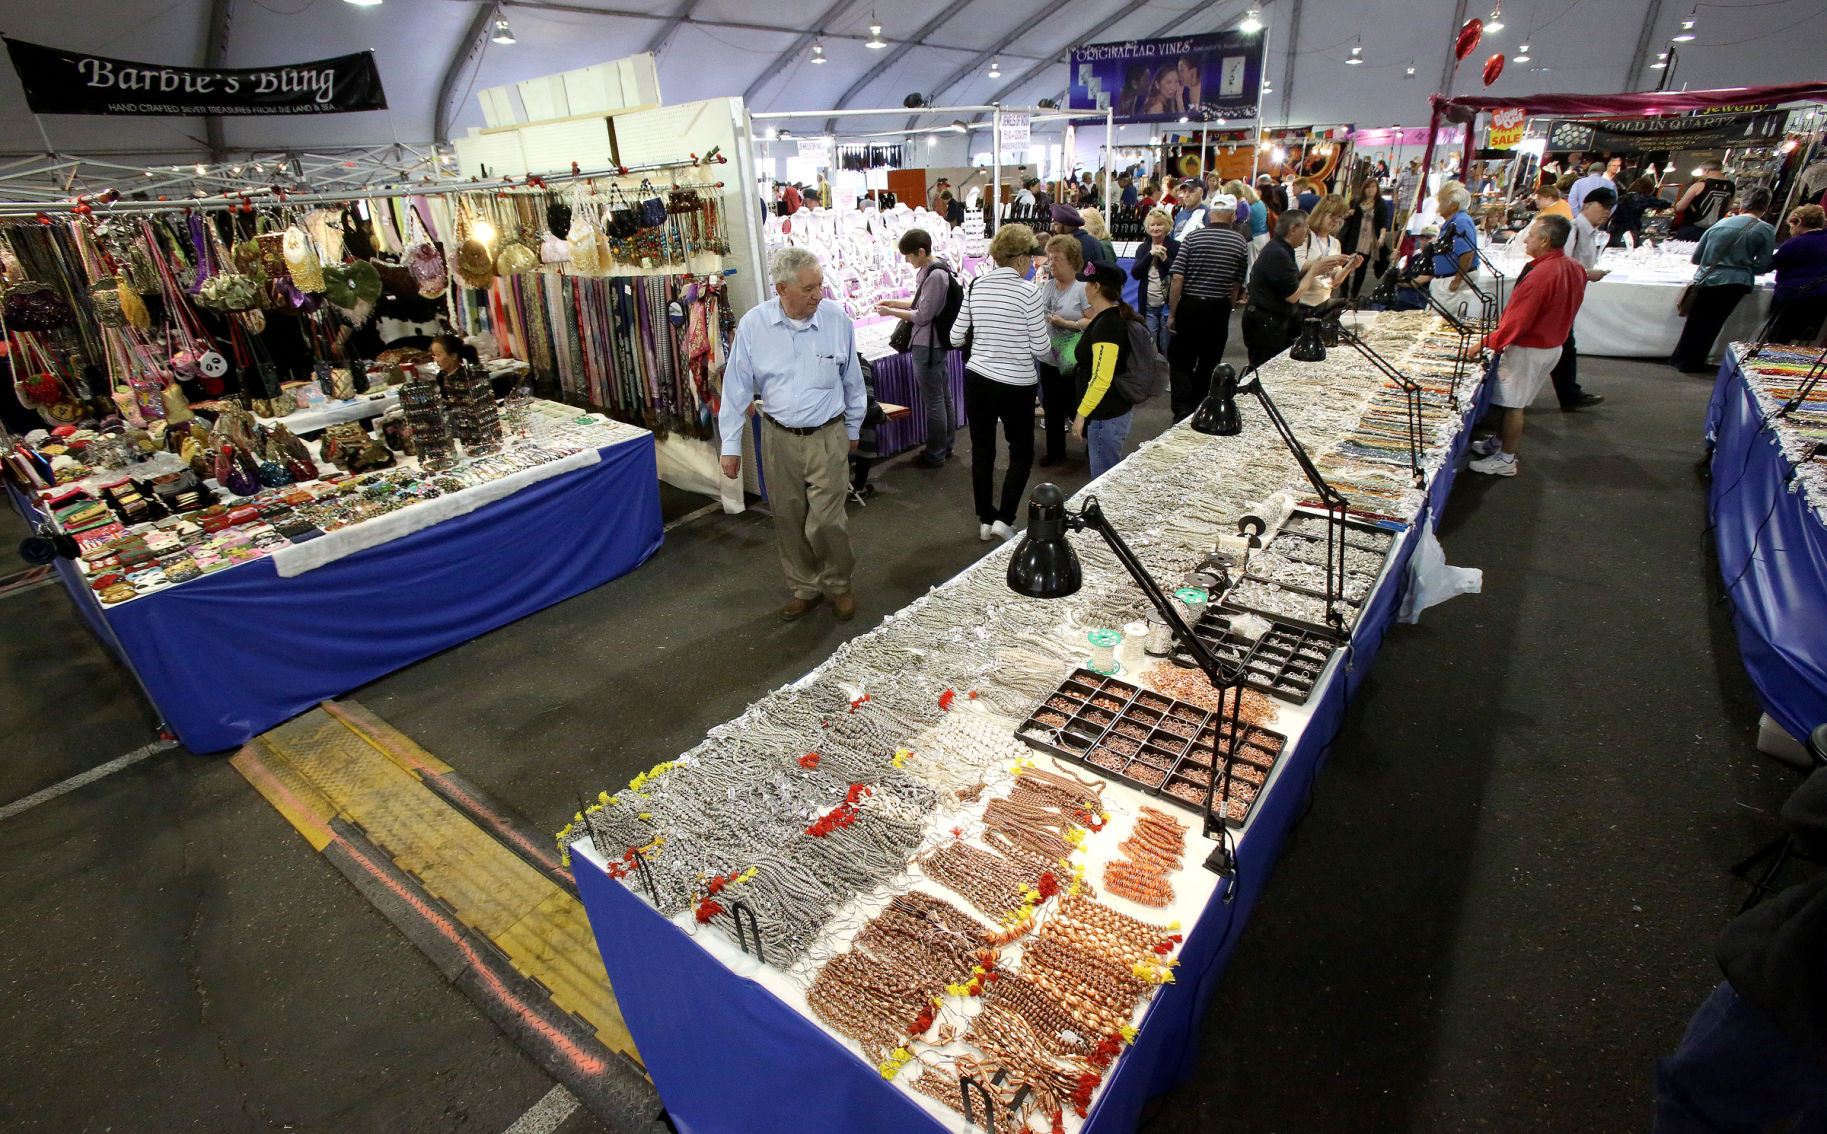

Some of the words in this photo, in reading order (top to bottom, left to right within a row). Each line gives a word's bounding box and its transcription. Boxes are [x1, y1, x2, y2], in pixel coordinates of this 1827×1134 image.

[1076, 46, 1130, 62] ORIGINAL
[1132, 44, 1156, 57] EAR
[77, 58, 240, 94] Barbie's
[250, 67, 336, 103] Bling
[108, 103, 138, 112] HAND
[139, 104, 180, 113] CRAFTED
[180, 105, 206, 114] SILVER
[207, 106, 252, 114] TREASURES
[253, 106, 277, 114] FROM
[279, 105, 291, 113] THE
[293, 104, 314, 113] LAND
[322, 103, 336, 112] SEA
[1604, 121, 1646, 132] GOLD
[1648, 119, 1668, 132] IN
[1669, 115, 1737, 131] QUARTZ
[1491, 133, 1521, 146] SALE
